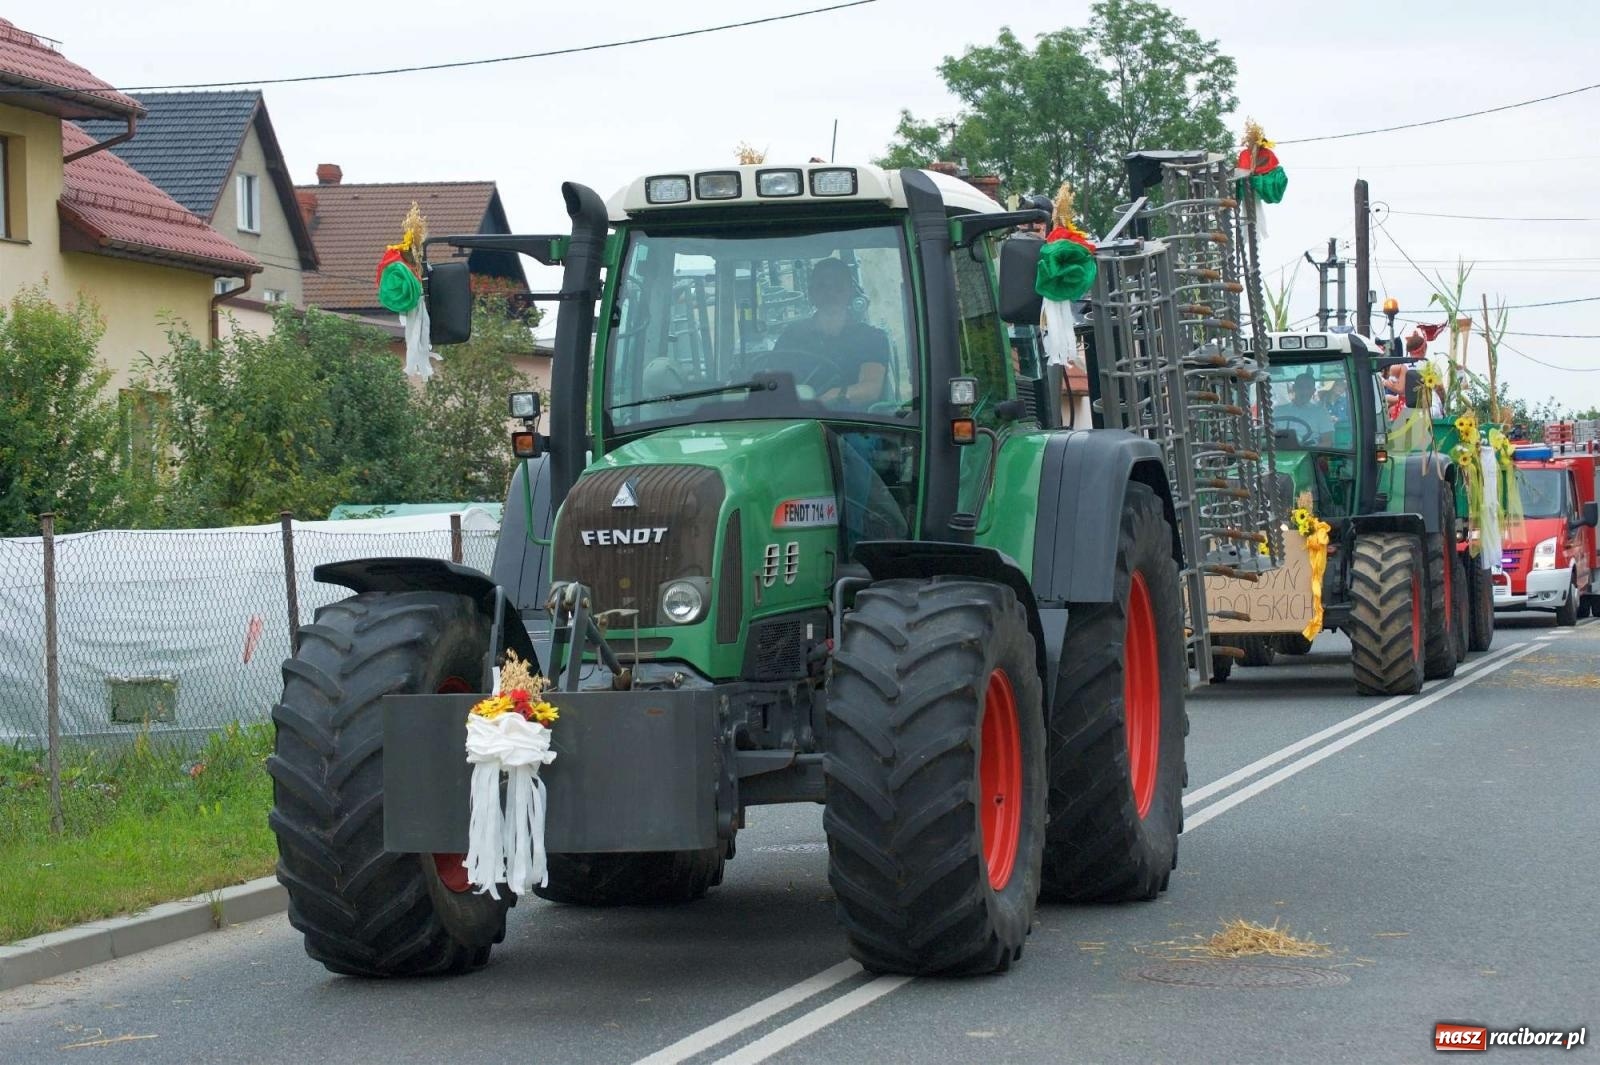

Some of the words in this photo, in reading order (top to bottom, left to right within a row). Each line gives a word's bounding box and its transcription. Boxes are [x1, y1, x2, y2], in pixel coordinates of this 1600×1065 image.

[784, 503, 811, 522] FENDT
[812, 503, 824, 521] 714
[580, 527, 669, 546] FENDT
